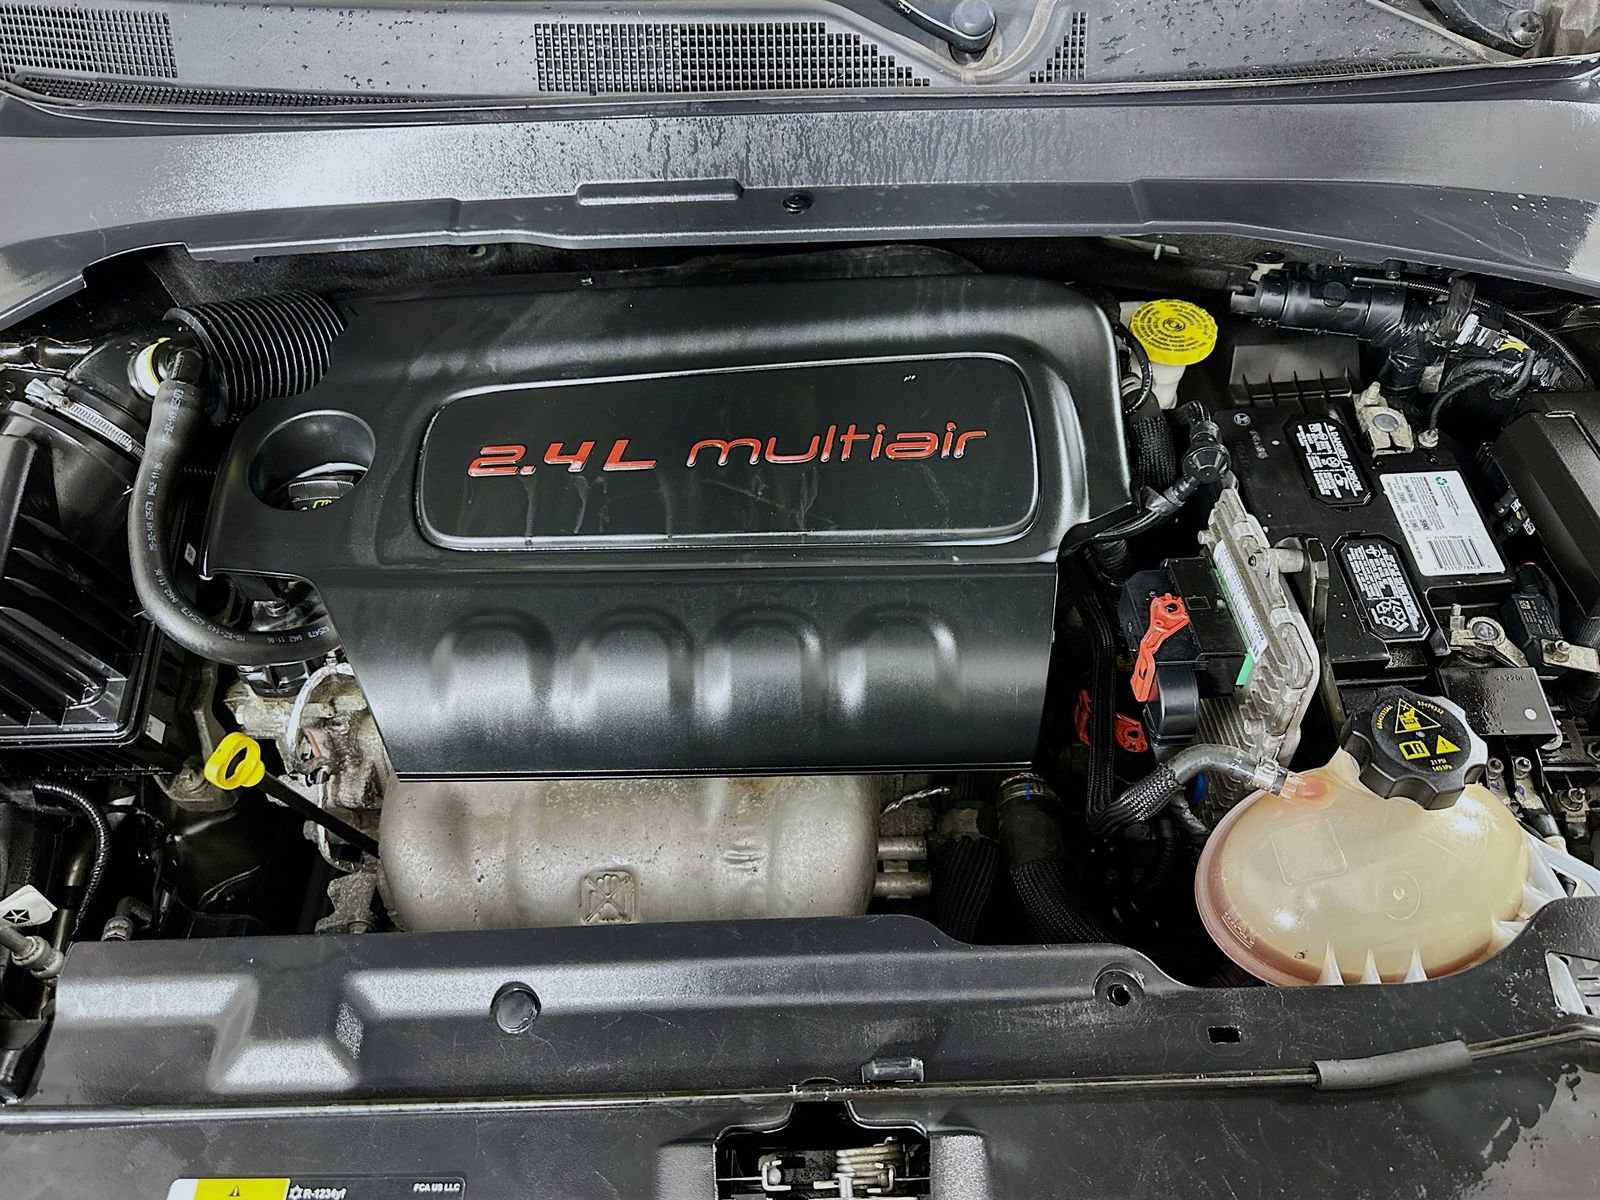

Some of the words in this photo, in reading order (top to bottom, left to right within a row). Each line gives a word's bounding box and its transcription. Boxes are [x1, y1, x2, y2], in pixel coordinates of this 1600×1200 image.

[686, 420, 989, 467] multiair
[1330, 431, 1348, 459] DANGER
[1344, 465, 1364, 491] POISON
[303, 1187, 347, 1199] R-1234yf
[413, 1182, 431, 1192] FCA
[431, 1182, 444, 1192] US
[444, 1182, 461, 1192] LLC
